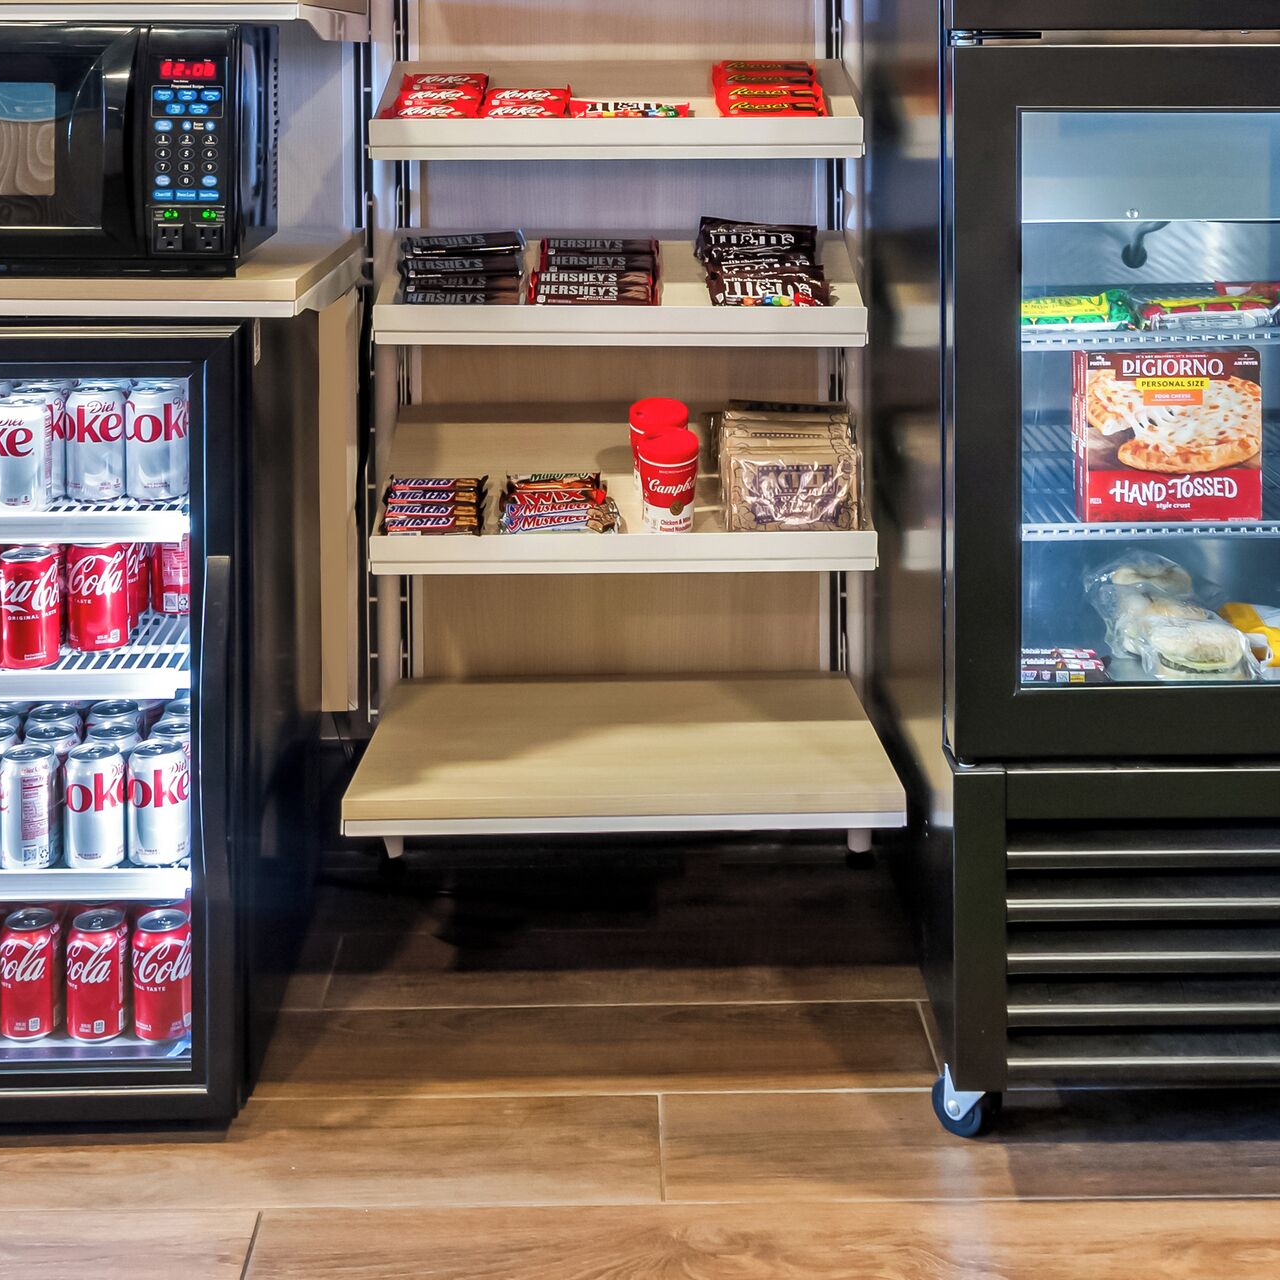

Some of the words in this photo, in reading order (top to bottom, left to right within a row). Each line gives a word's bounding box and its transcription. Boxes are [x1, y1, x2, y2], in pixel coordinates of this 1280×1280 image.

[549, 239, 624, 249] HERSHEY'S
[551, 256, 627, 266] HERSHEY'S
[540, 272, 618, 282] HERSHEY'S
[539, 285, 619, 296] HERSHEY'S
[1141, 380, 1185, 388] PERSONAL
[87, 401, 115, 414] Diet
[390, 490, 455, 500] SNICKERS
[1109, 475, 1238, 506] HAND-TOSSED
[513, 489, 586, 505] TWIX
[387, 504, 455, 515] SNICKERS
[660, 518, 677, 526] Chicken
